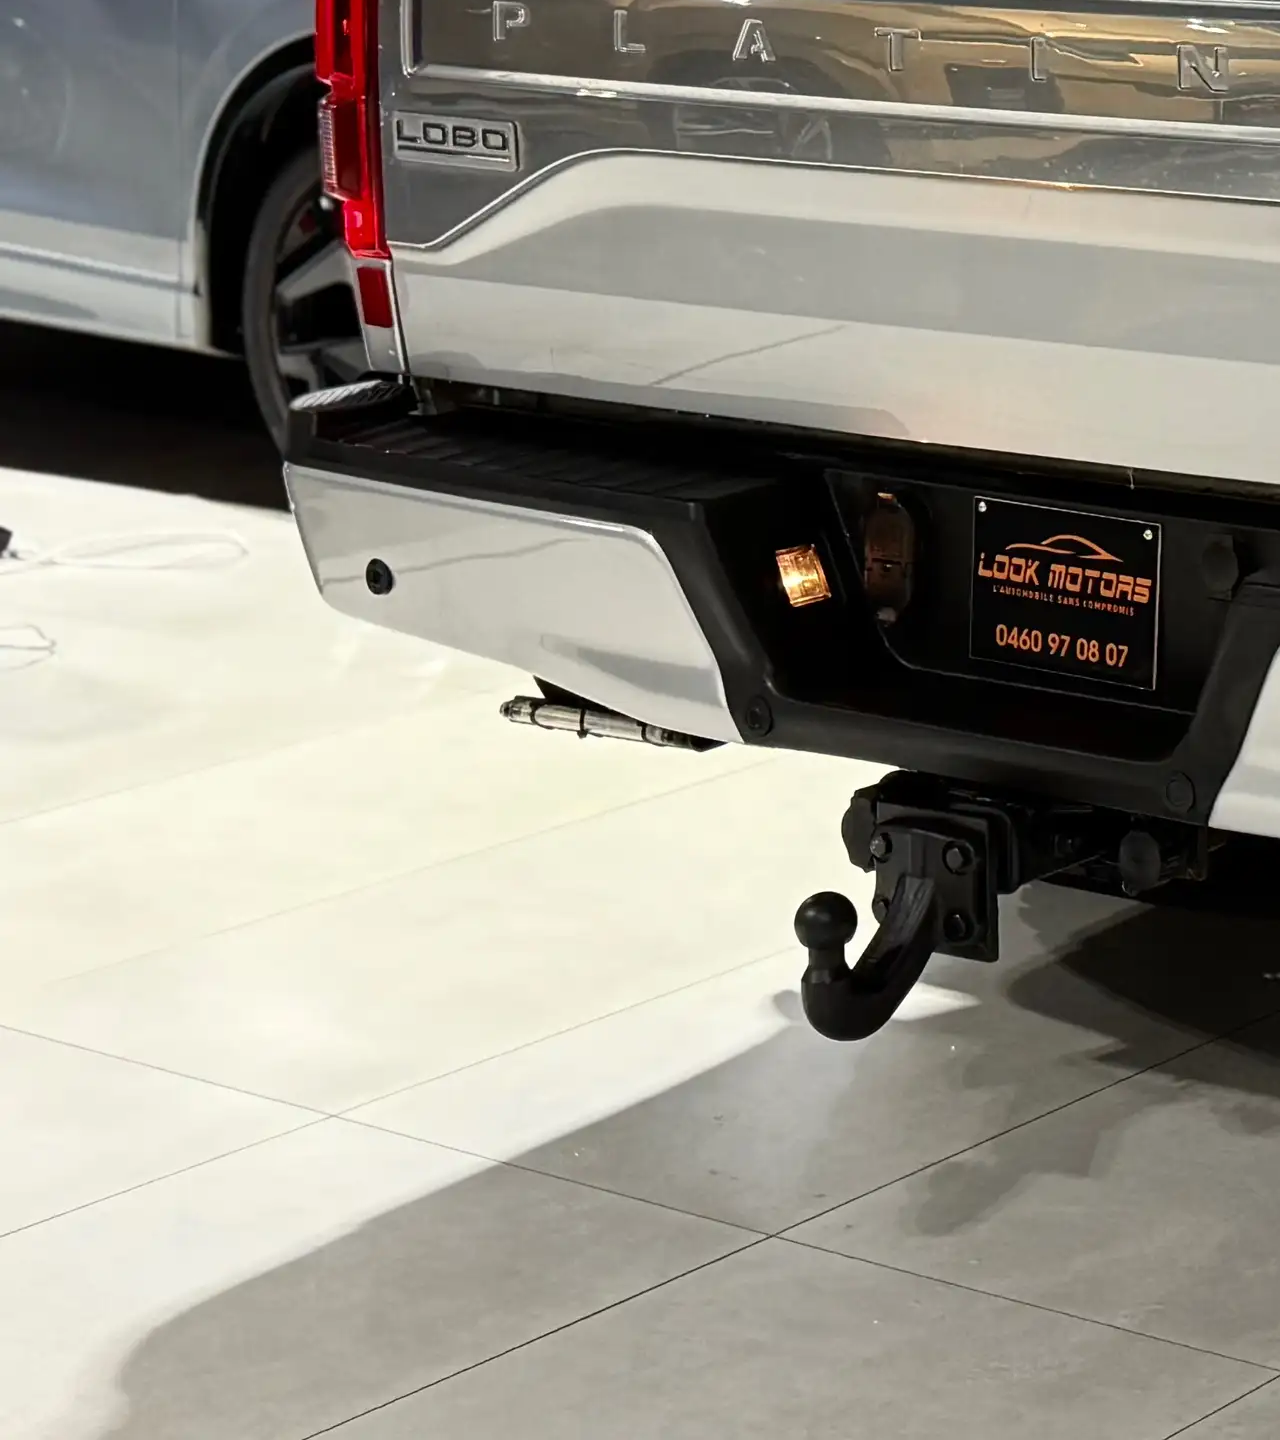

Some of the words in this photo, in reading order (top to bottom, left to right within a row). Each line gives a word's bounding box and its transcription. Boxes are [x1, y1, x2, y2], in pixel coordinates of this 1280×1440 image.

[396, 119, 509, 151] LOBO
[978, 552, 1040, 585] LOOK
[1048, 564, 1152, 603] MOTORS
[993, 585, 1054, 602] L'AUTOMOBILE
[1057, 595, 1080, 606] SANS
[1083, 600, 1134, 616] COMPROMIS
[996, 624, 1042, 652] 0460
[1048, 634, 1070, 656] 97
[1076, 638, 1099, 662] 08
[1106, 644, 1128, 667] 07
